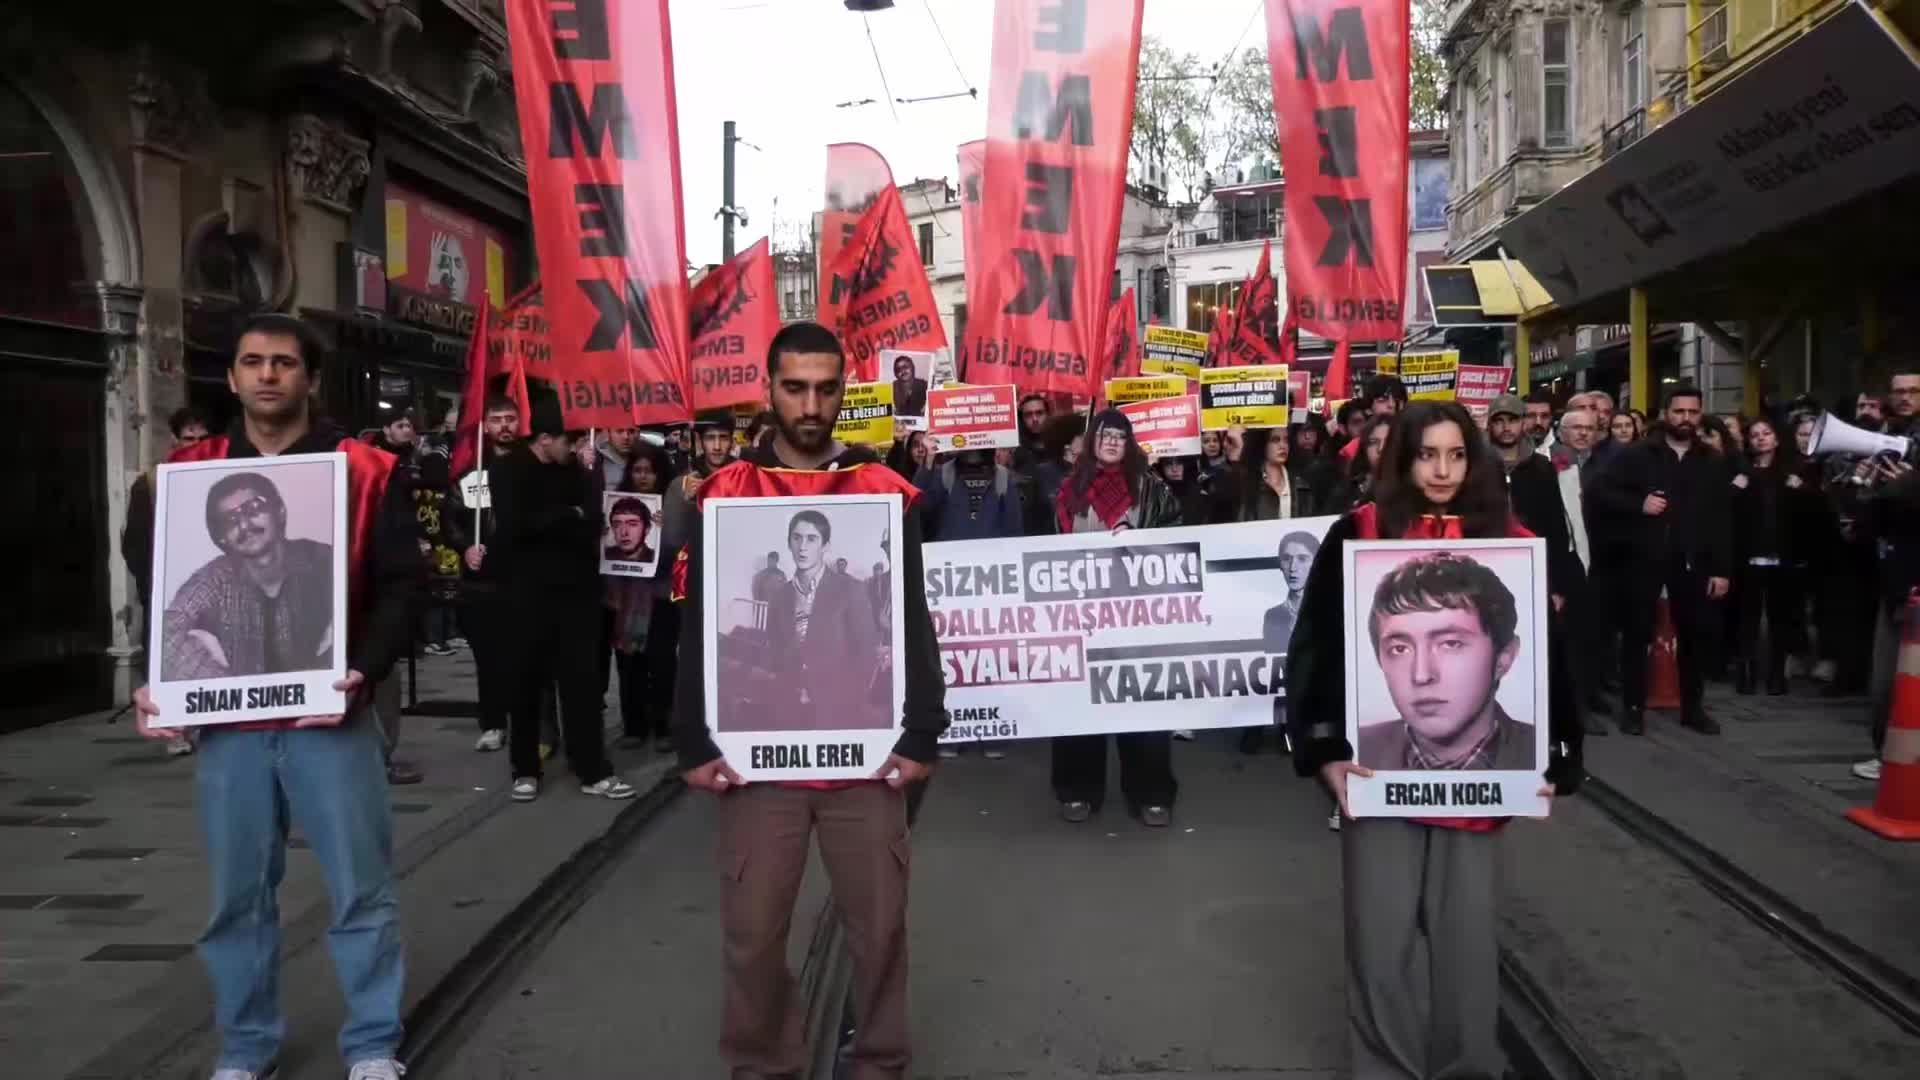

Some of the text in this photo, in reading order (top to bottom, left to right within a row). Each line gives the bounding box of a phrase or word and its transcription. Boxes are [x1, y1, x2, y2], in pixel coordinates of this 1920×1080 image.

[926, 552, 1199, 605] ŞİZME GEÇİT YOK!
[930, 595, 1212, 638] DALLAR YAŞAYACAK,
[941, 642, 1081, 686] SYALİZM
[1090, 656, 1288, 705] KAZANACA
[185, 683, 306, 714] SİNAN SUNER
[953, 706, 1000, 721] EMEK
[751, 743, 864, 769] ERDAL EREN
[1385, 782, 1503, 806] ERCAN KOCA
